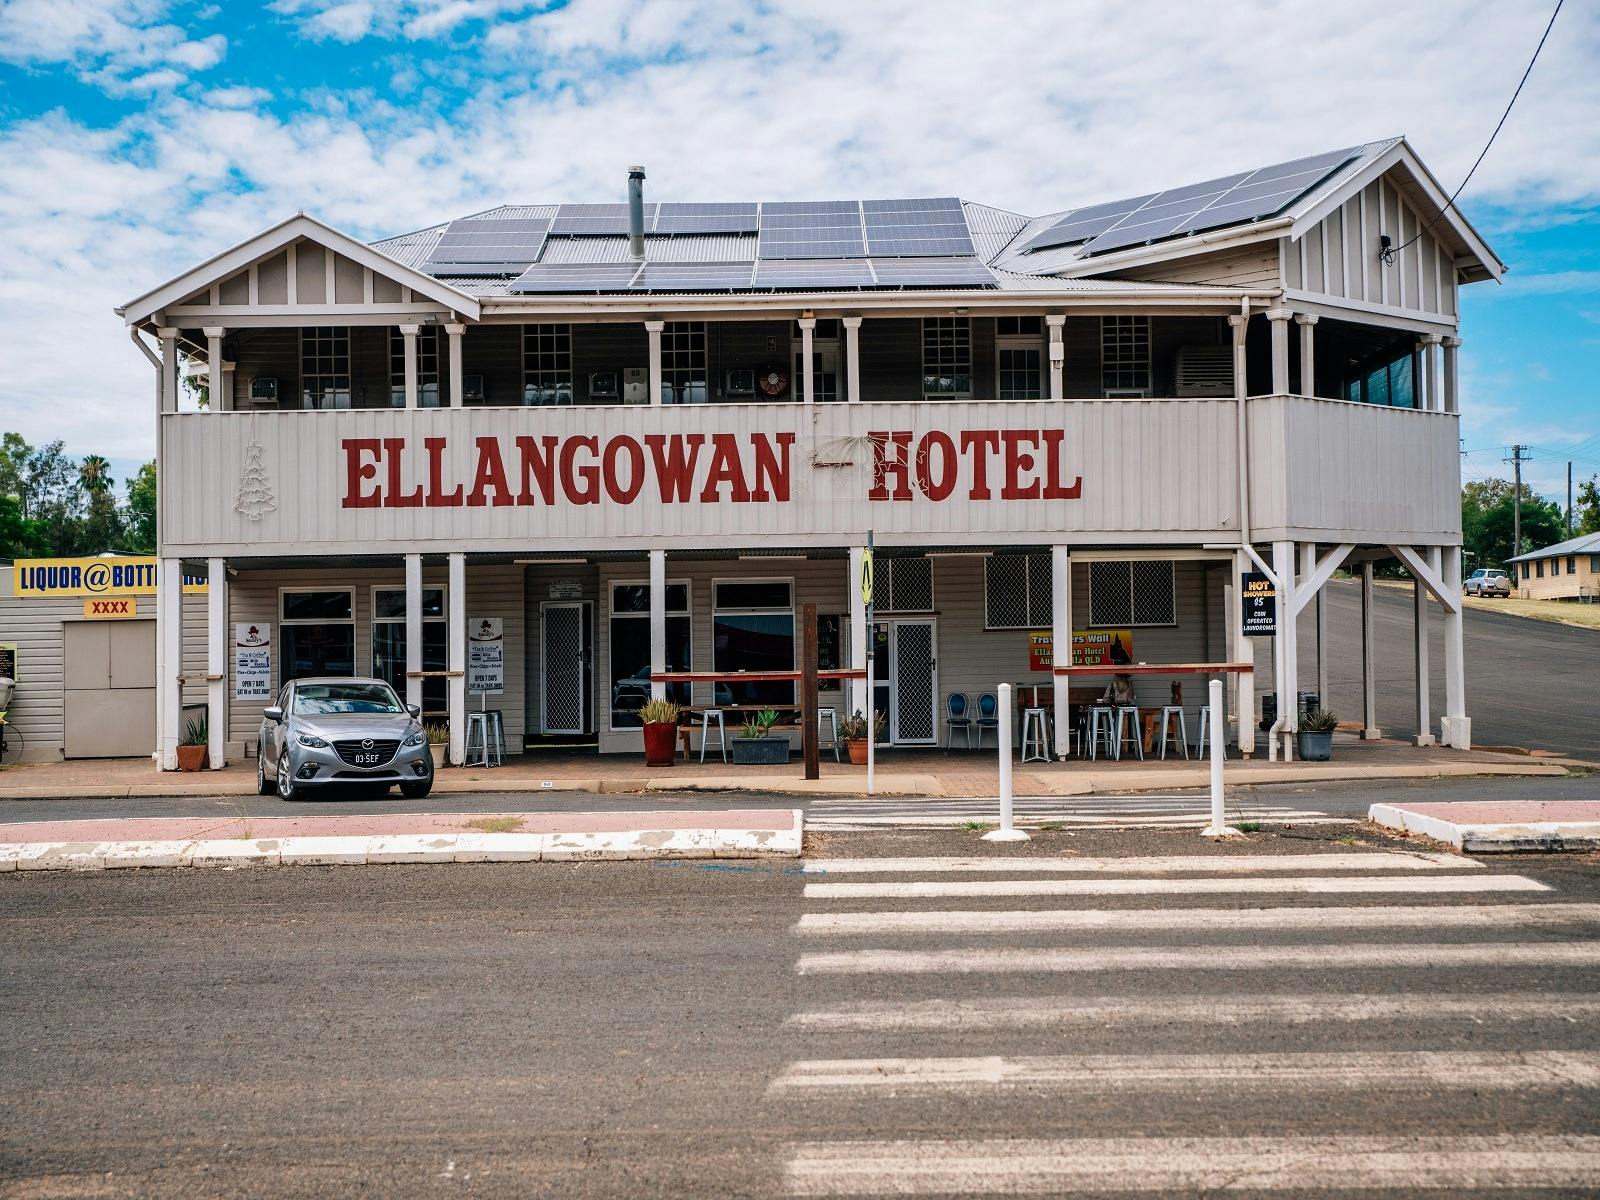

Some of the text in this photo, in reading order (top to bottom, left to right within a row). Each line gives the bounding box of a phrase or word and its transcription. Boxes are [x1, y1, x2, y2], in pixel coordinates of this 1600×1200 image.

[342, 429, 1083, 508] ELLANGOWAN HOTEL
[1249, 581, 1269, 590] HOT
[1254, 597, 1264, 606] $5
[92, 601, 128, 614] XXXX
[1088, 634, 1109, 643] Wall
[1084, 647, 1105, 655] Hotel
[1085, 656, 1100, 665] QLD
